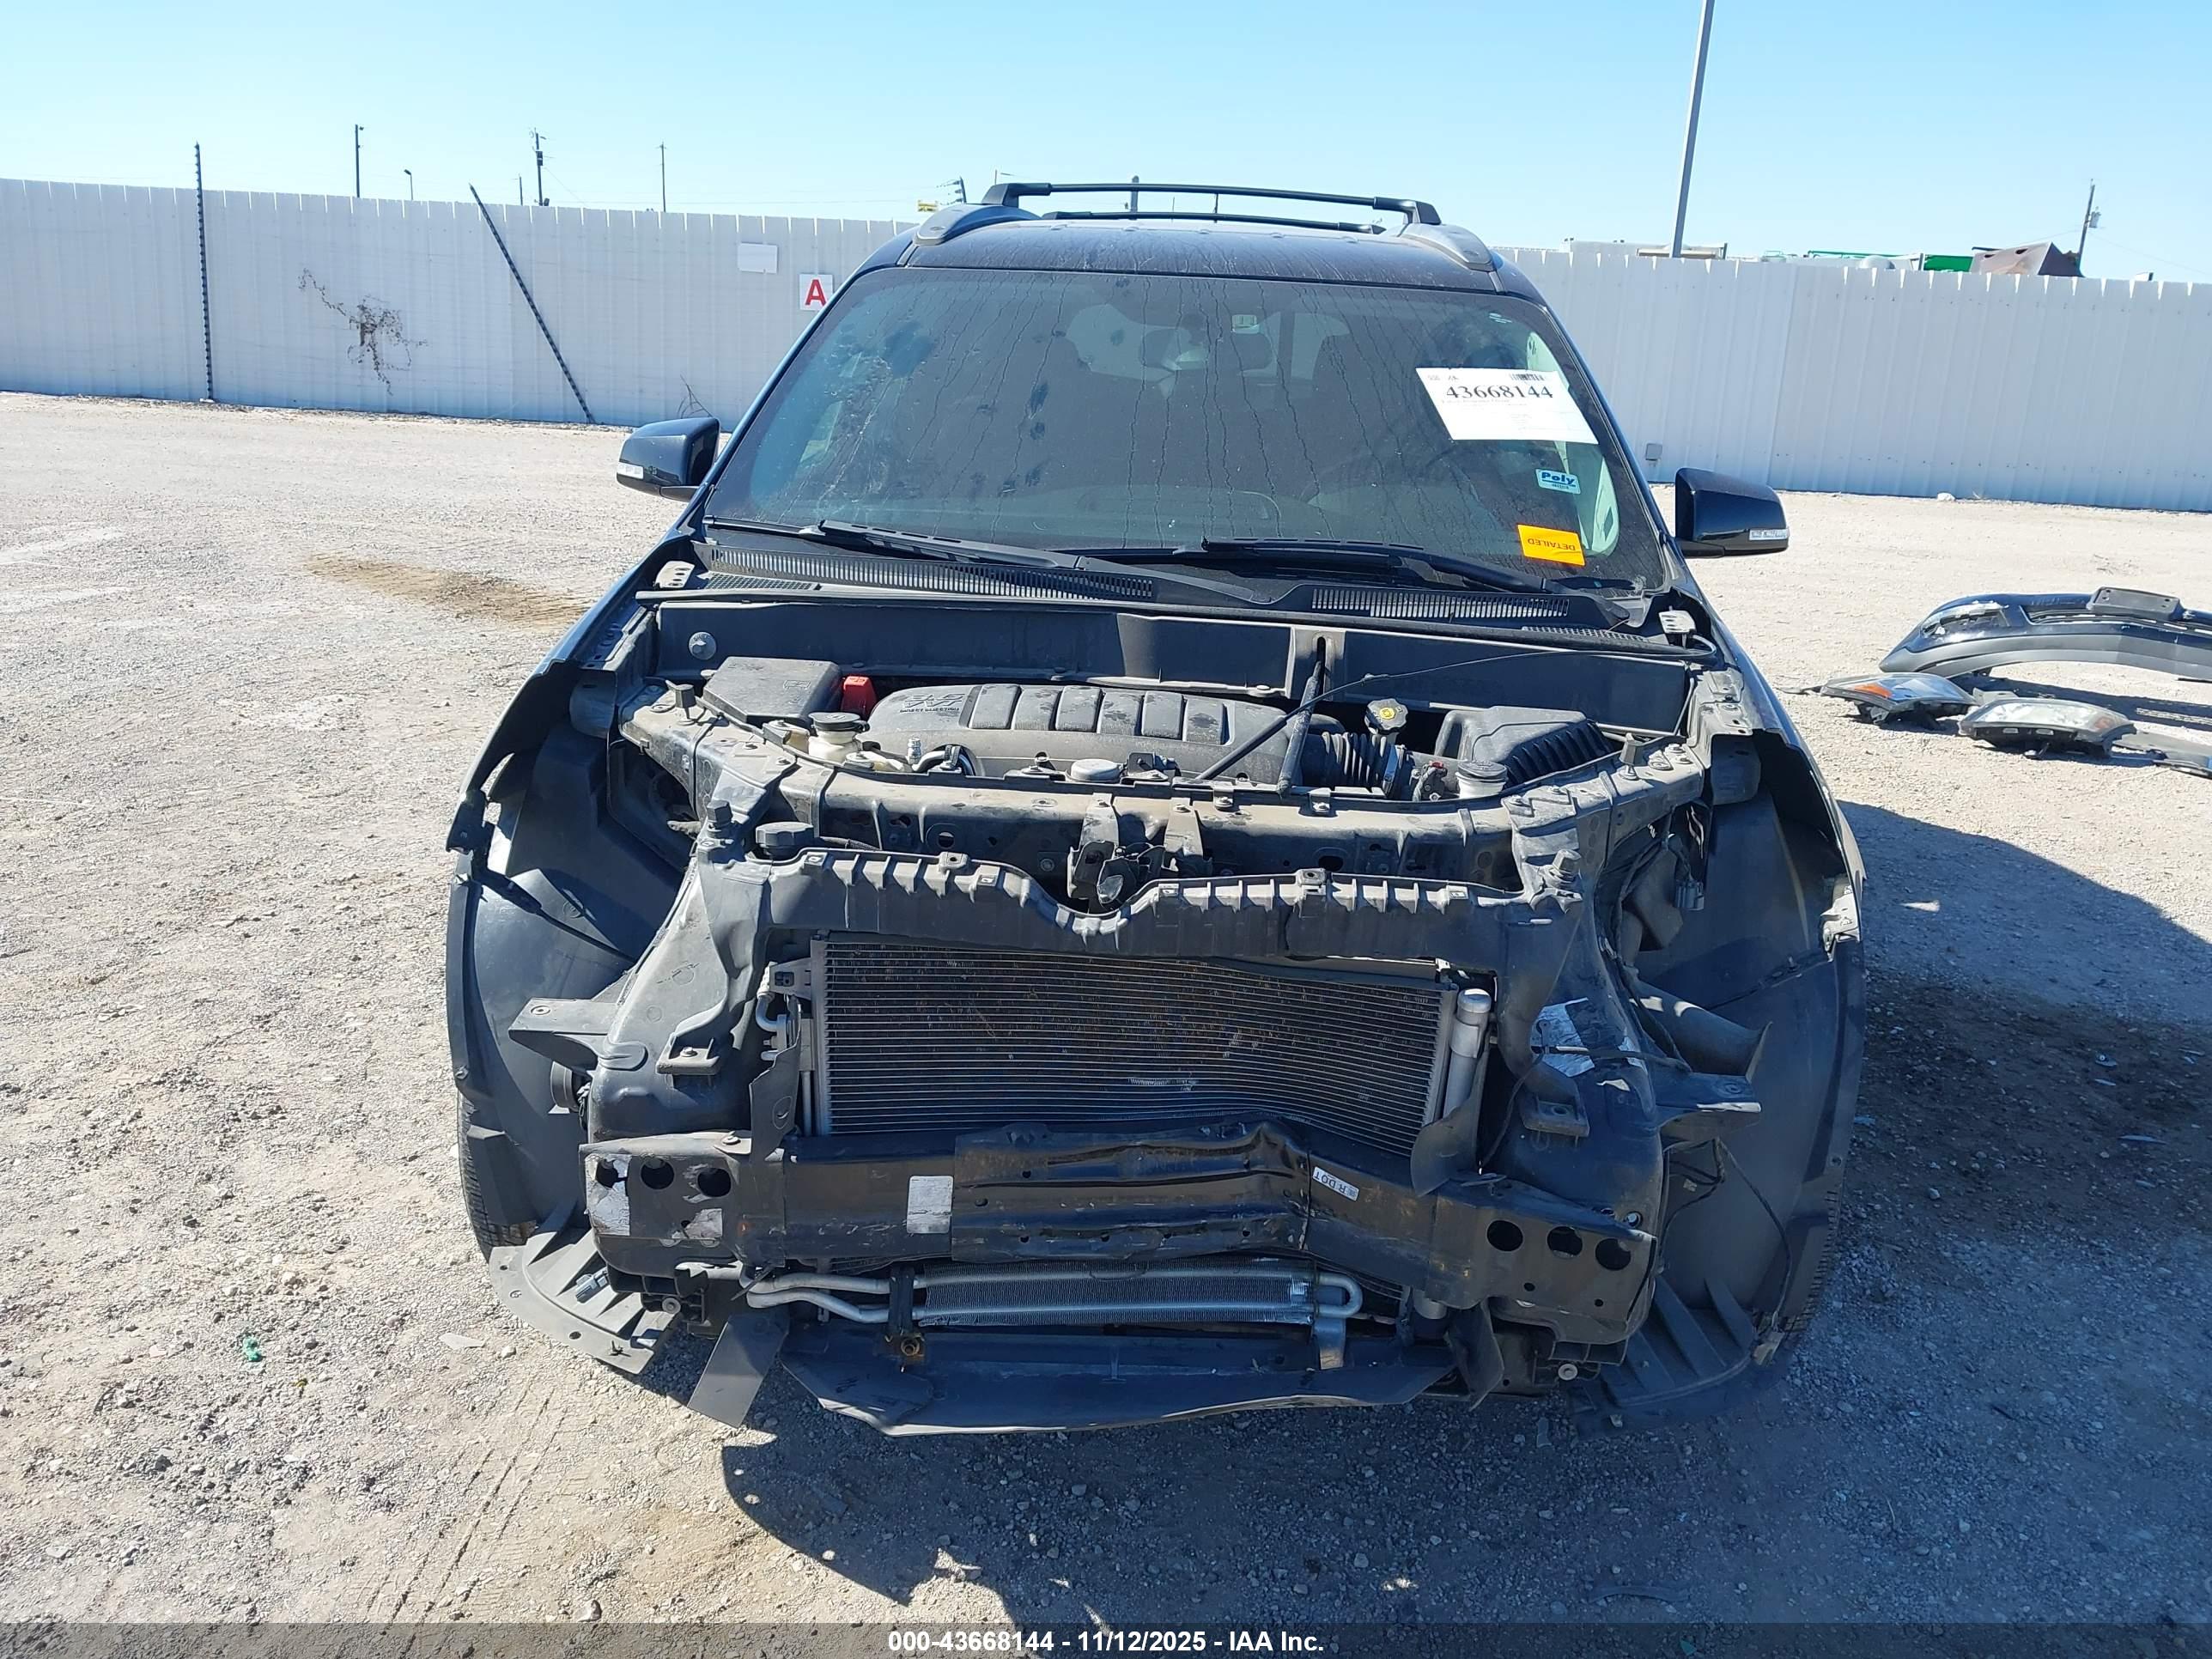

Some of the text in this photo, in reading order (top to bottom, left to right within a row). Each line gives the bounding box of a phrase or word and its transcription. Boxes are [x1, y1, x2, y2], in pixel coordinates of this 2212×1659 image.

[805, 278, 827, 307] A
[1446, 384, 1553, 398] 43668144
[1541, 471, 1575, 485] Poly
[1527, 538, 1576, 551] DETAILED
[1314, 1170, 1336, 1189] DOT
